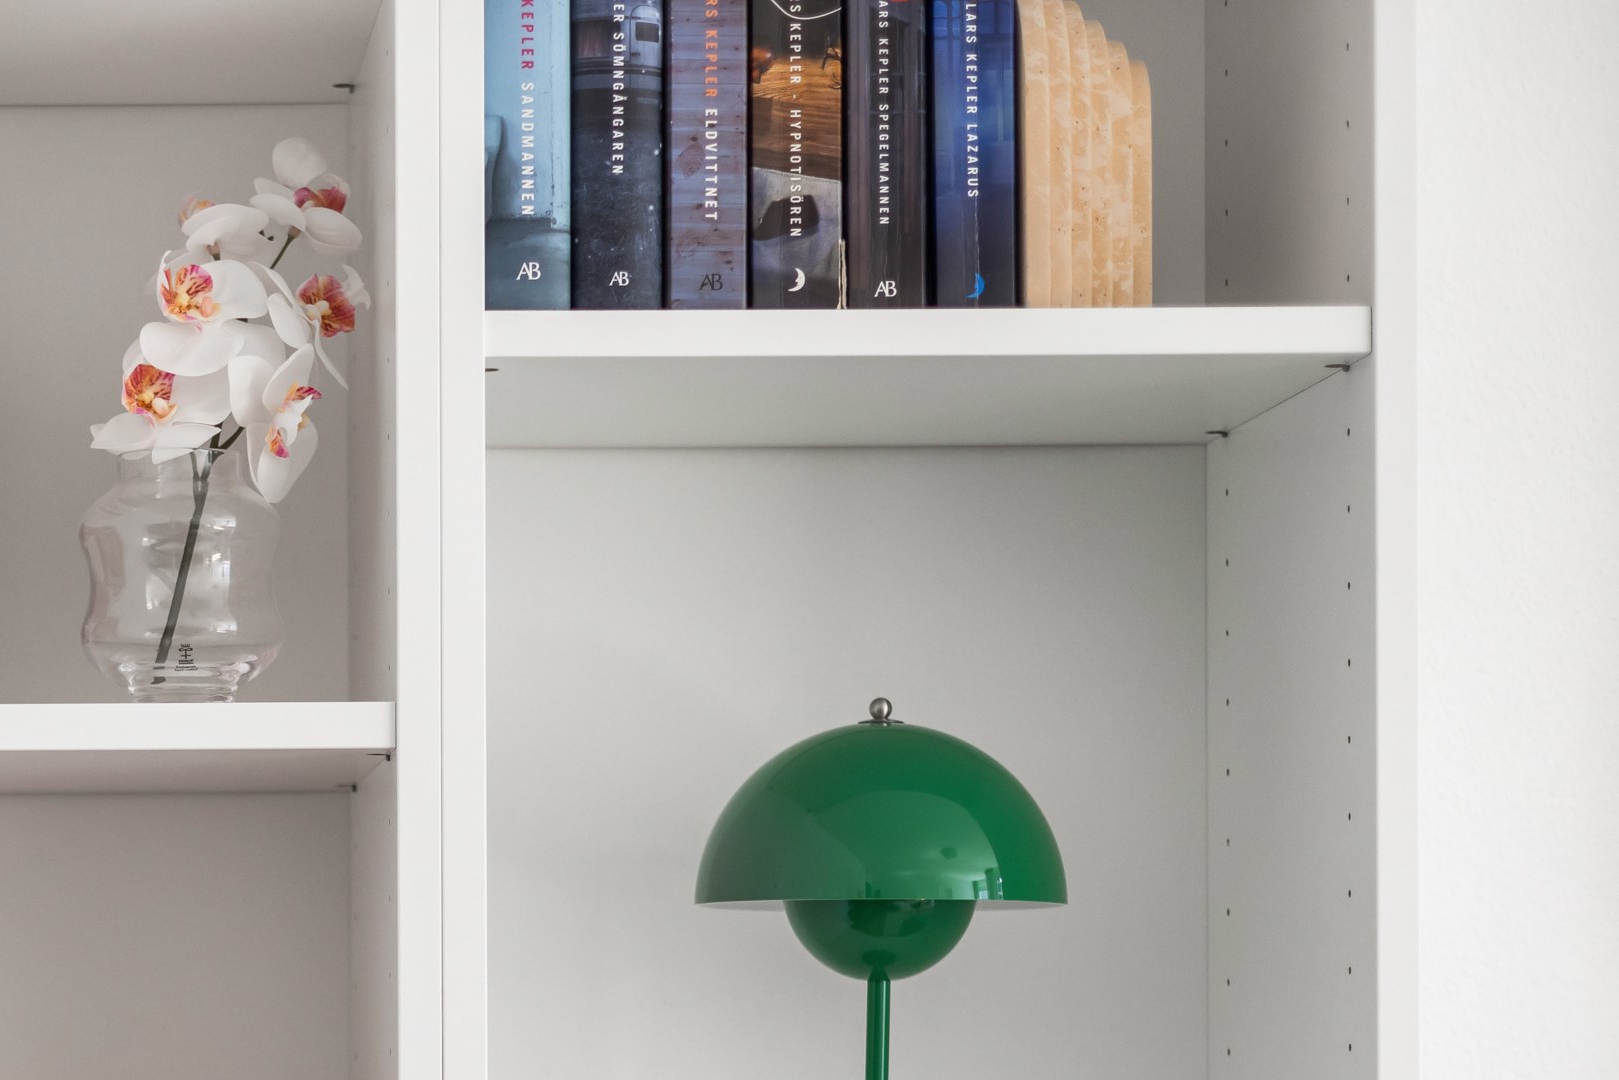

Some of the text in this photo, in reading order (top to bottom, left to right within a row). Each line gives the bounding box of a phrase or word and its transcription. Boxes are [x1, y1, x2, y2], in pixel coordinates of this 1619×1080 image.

[521, 0, 534, 215] KEPLER SANDMANNEN
[612, 33, 626, 174] SÖMNGÅNGAREN
[705, 30, 718, 97] KEPLER
[965, 3, 979, 198] LARS KEPLER LAZARUS
[705, 109, 718, 220] ELDVITTNET
